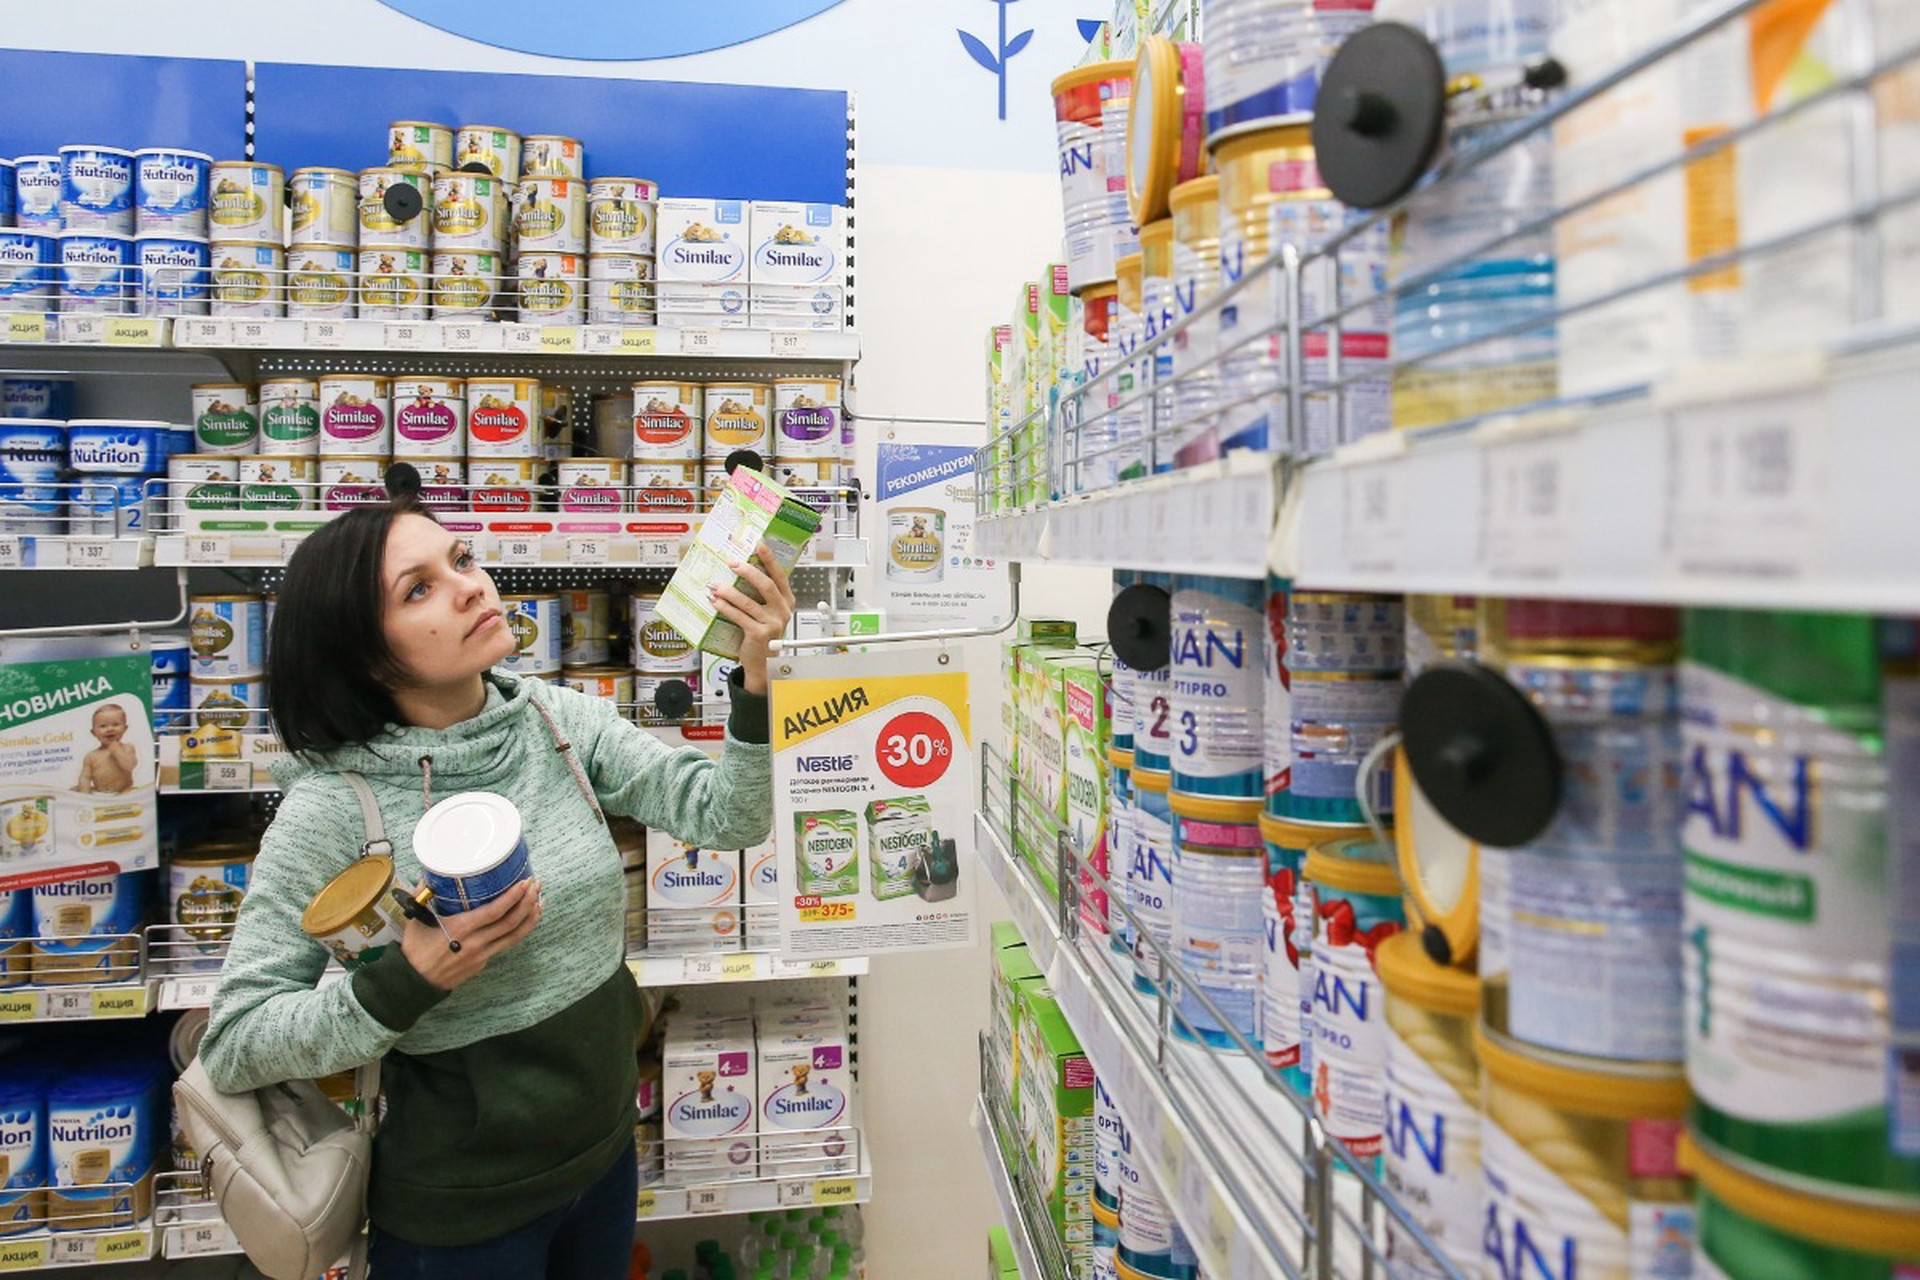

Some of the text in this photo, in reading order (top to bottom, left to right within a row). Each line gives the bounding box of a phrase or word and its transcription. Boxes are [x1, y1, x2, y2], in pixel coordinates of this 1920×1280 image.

[1061, 143, 1092, 176] AN
[75, 166, 128, 181] Nutrilon
[144, 169, 194, 182] Nutrilon
[20, 176, 60, 187] Nutrilo
[717, 206, 722, 222] 1
[808, 209, 813, 223] 1
[65, 251, 117, 264] Nutrilon
[145, 254, 196, 267] Nutrilon
[407, 254, 415, 267] 2
[674, 248, 732, 265] Similac
[766, 250, 823, 267] Similac
[115, 328, 149, 338] АКЦИЯ
[267, 412, 314, 426] Similac
[329, 409, 376, 424] Similac
[402, 412, 449, 426] Similac
[474, 412, 520, 427] Similac
[640, 416, 684, 429] Similac
[786, 412, 830, 426] Similac
[203, 418, 249, 431] Similac
[714, 417, 759, 431] Similac
[74, 449, 140, 464] Nutrilon
[887, 454, 975, 492] РЕКОМЕНДУЕМ
[197, 491, 232, 503] Simil
[245, 491, 292, 502] Similac
[478, 492, 524, 504] Similac
[568, 492, 614, 505] Similac
[642, 493, 687, 506] Similac
[127, 508, 142, 528] 2
[88, 546, 104, 557] 337
[581, 543, 596, 554] 715
[652, 543, 668, 554] 715
[522, 603, 529, 612] 3
[851, 621, 862, 634] 2
[644, 630, 686, 642] Simila
[0, 676, 113, 722] НОВИНКА
[783, 686, 869, 740] АКЦИЯ
[1150, 695, 1170, 738] 2
[1180, 711, 1198, 756] 3
[797, 754, 853, 772] Nestlé
[807, 837, 853, 852] NESTOGEN
[880, 831, 927, 851] NESTOGEN
[825, 857, 834, 871] 3
[898, 855, 907, 870] 4
[664, 872, 724, 889] Similac
[34, 879, 114, 897] Nutrilon
[181, 898, 239, 914] Similac
[797, 897, 820, 908] -30%
[96, 954, 113, 975] 4
[62, 997, 79, 1008] 851
[98, 1000, 134, 1009] АКЦИЯ
[720, 1060, 732, 1074] 4
[814, 1053, 825, 1068] 4
[679, 1104, 739, 1122] Similac
[774, 1096, 833, 1116] Similac
[52, 1123, 132, 1142] Nutrilon
[820, 1185, 852, 1196] АКЦИЯ
[114, 1196, 130, 1213] 4
[637, 1199, 654, 1208] ЦИЯ
[13, 1204, 31, 1222] 4
[106, 1238, 142, 1251] АКЦИЯ
[2, 1251, 39, 1264] АКЦИЯ
